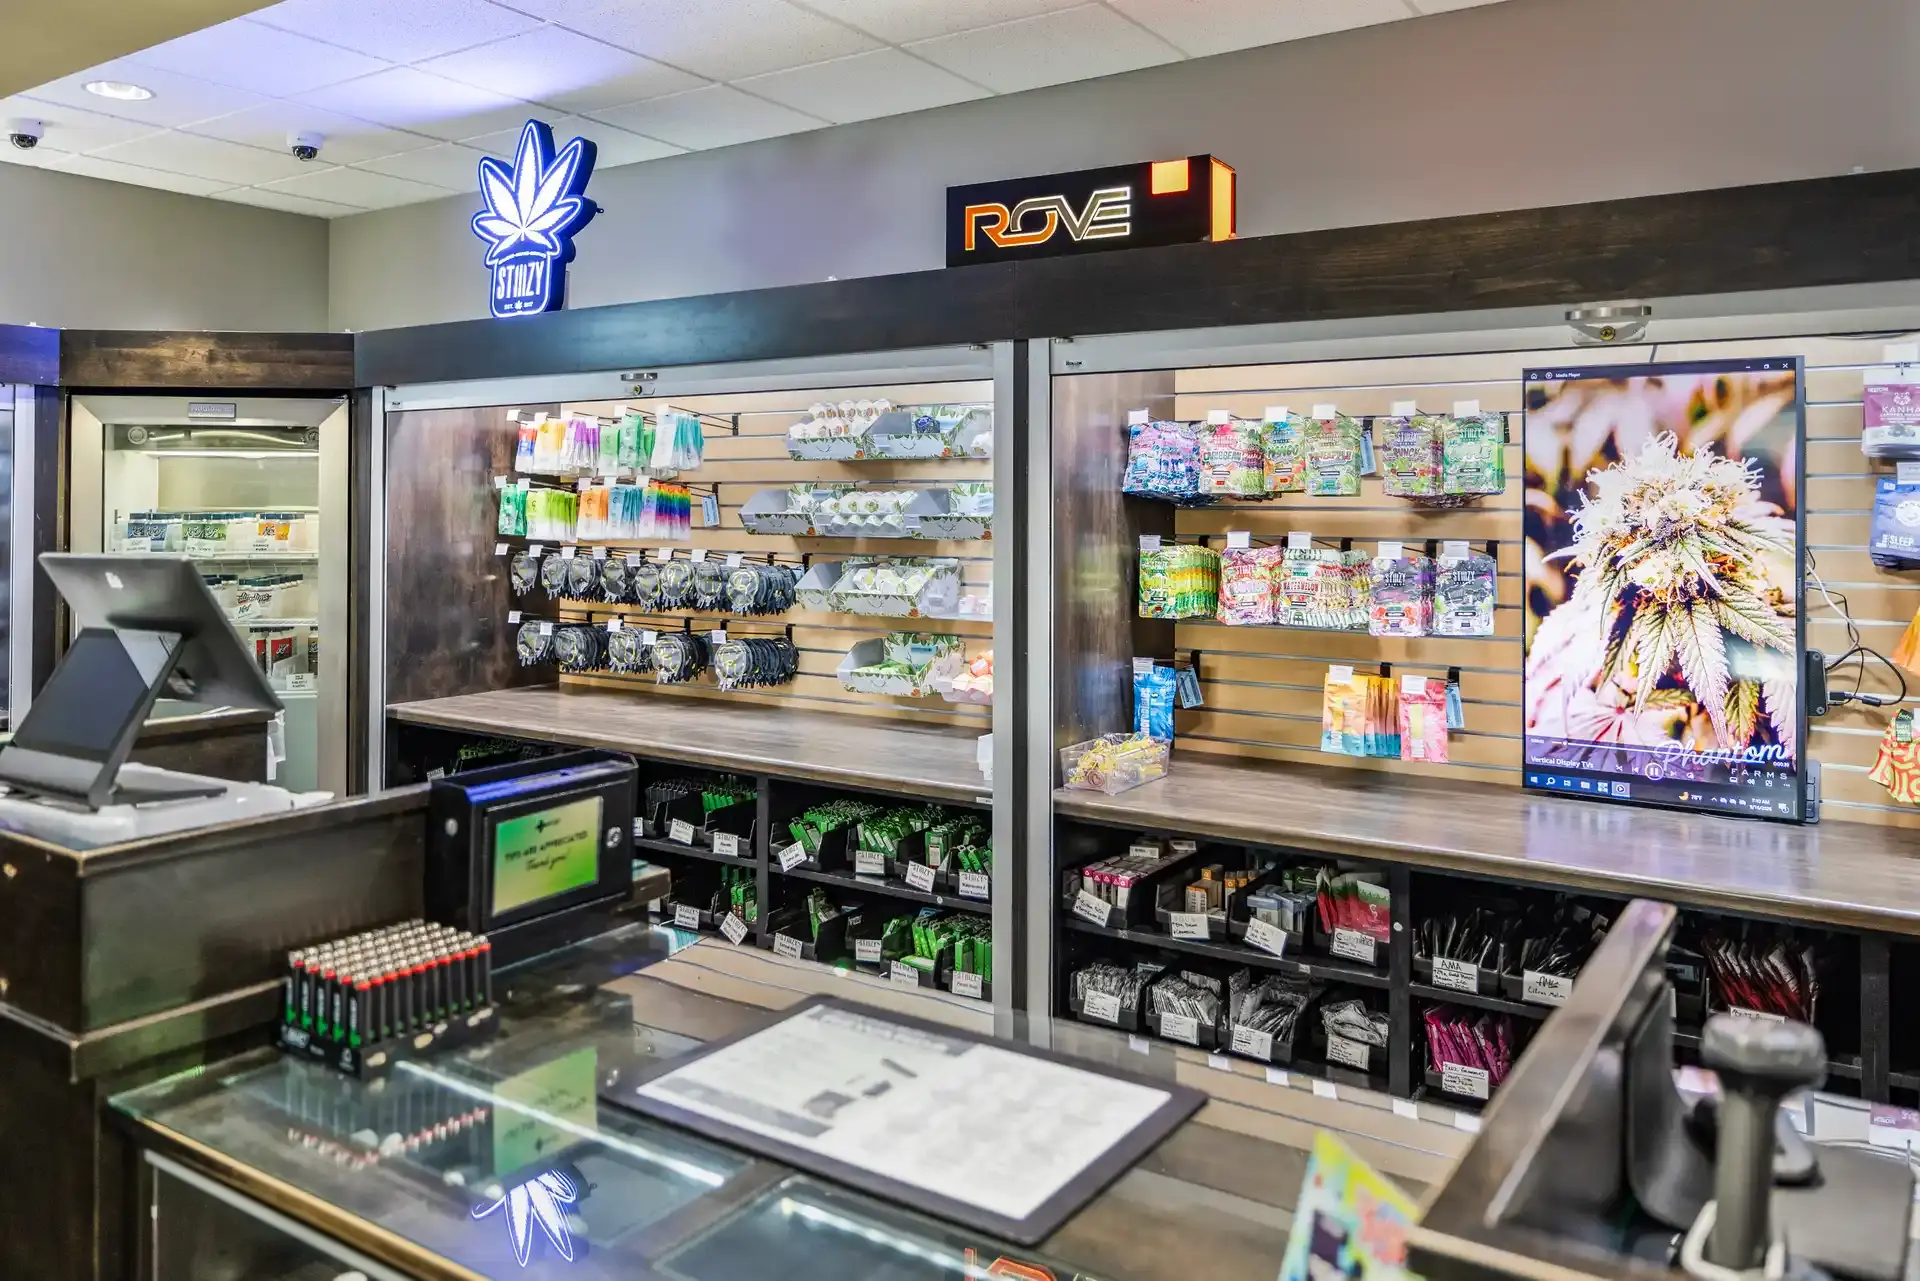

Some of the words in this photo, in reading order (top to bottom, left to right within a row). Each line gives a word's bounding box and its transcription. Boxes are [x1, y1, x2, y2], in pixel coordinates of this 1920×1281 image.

[964, 186, 1131, 250] ROVE
[496, 261, 545, 300] STIIIZY
[1890, 534, 1914, 547] SLEEP
[1283, 581, 1319, 592] WATERMELON
[1654, 738, 1789, 772] Phantom
[1530, 756, 1555, 765] Vertical
[1556, 759, 1580, 769] Display
[1581, 761, 1594, 769] TVs
[1732, 768, 1788, 780] FARMS
[540, 830, 588, 851] APPRECIATED
[1441, 960, 1462, 971] AMA
